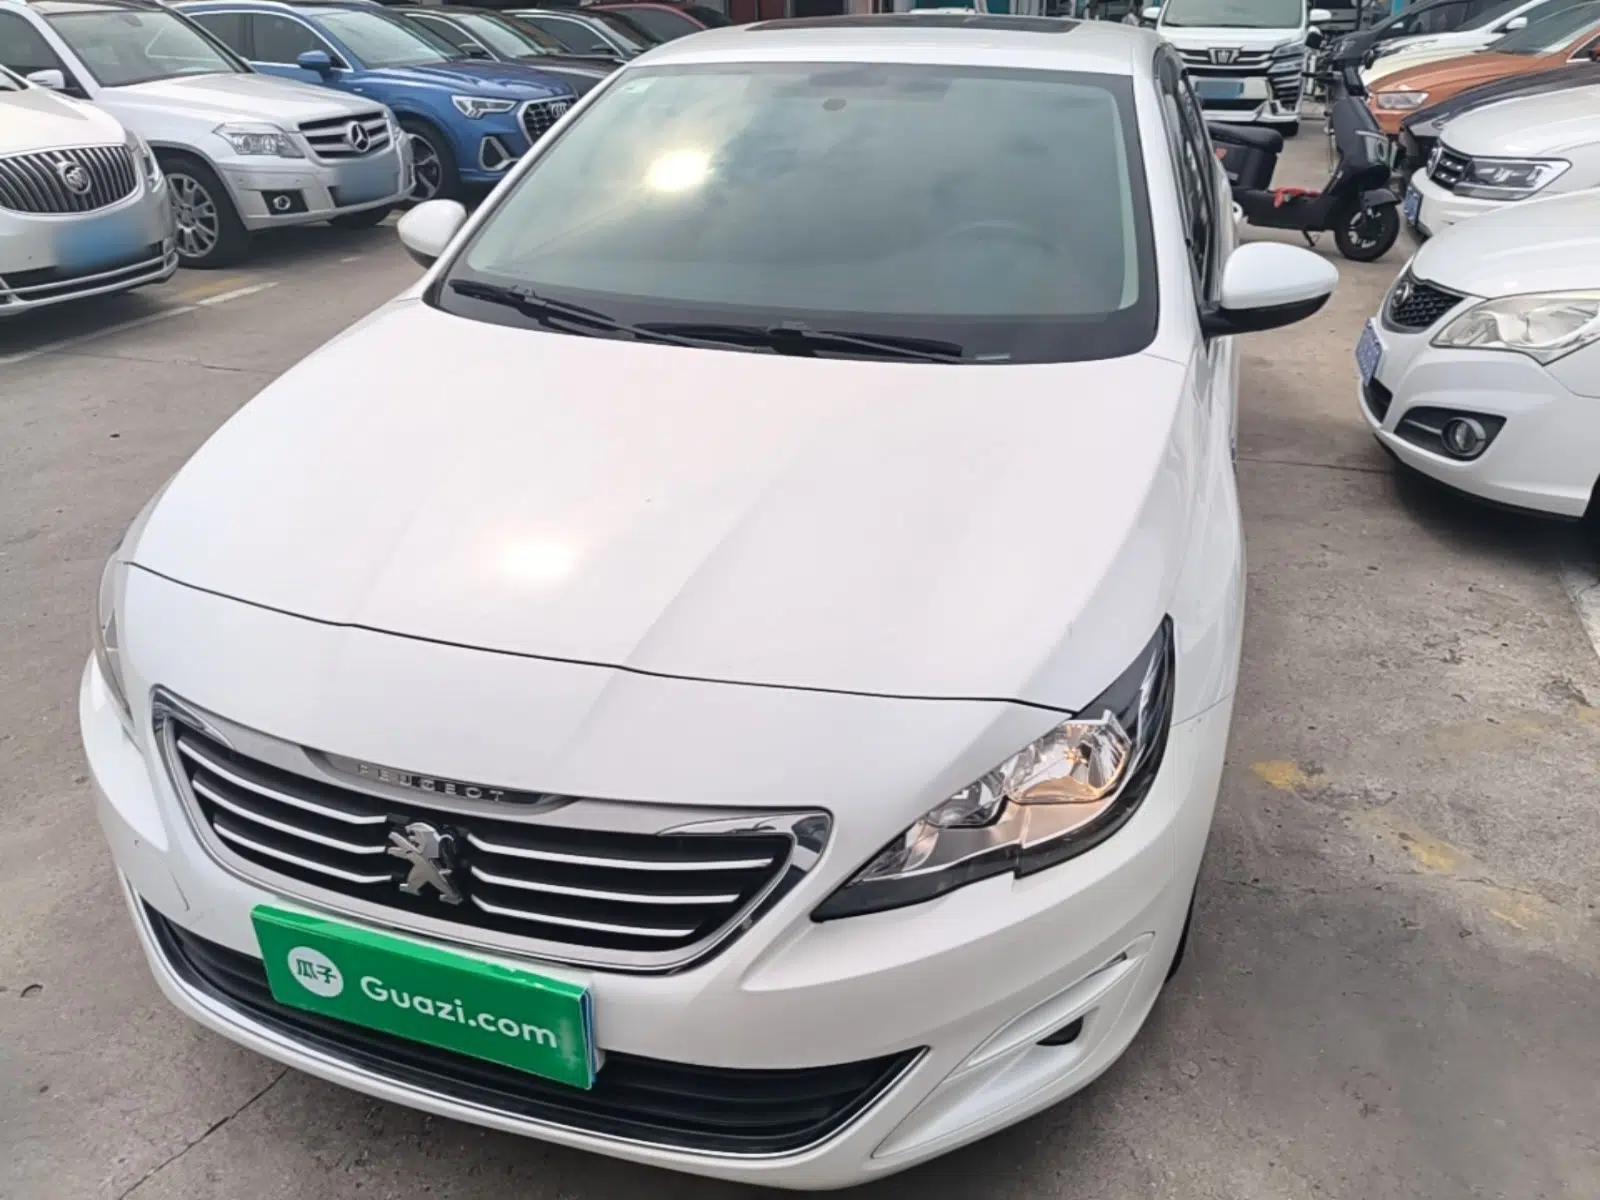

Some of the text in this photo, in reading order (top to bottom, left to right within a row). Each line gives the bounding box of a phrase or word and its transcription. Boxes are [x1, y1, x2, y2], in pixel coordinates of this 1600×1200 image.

[358, 763, 504, 802] PEUGEOT
[295, 957, 338, 985] 瓜子
[359, 974, 558, 1049] Guazi.com
